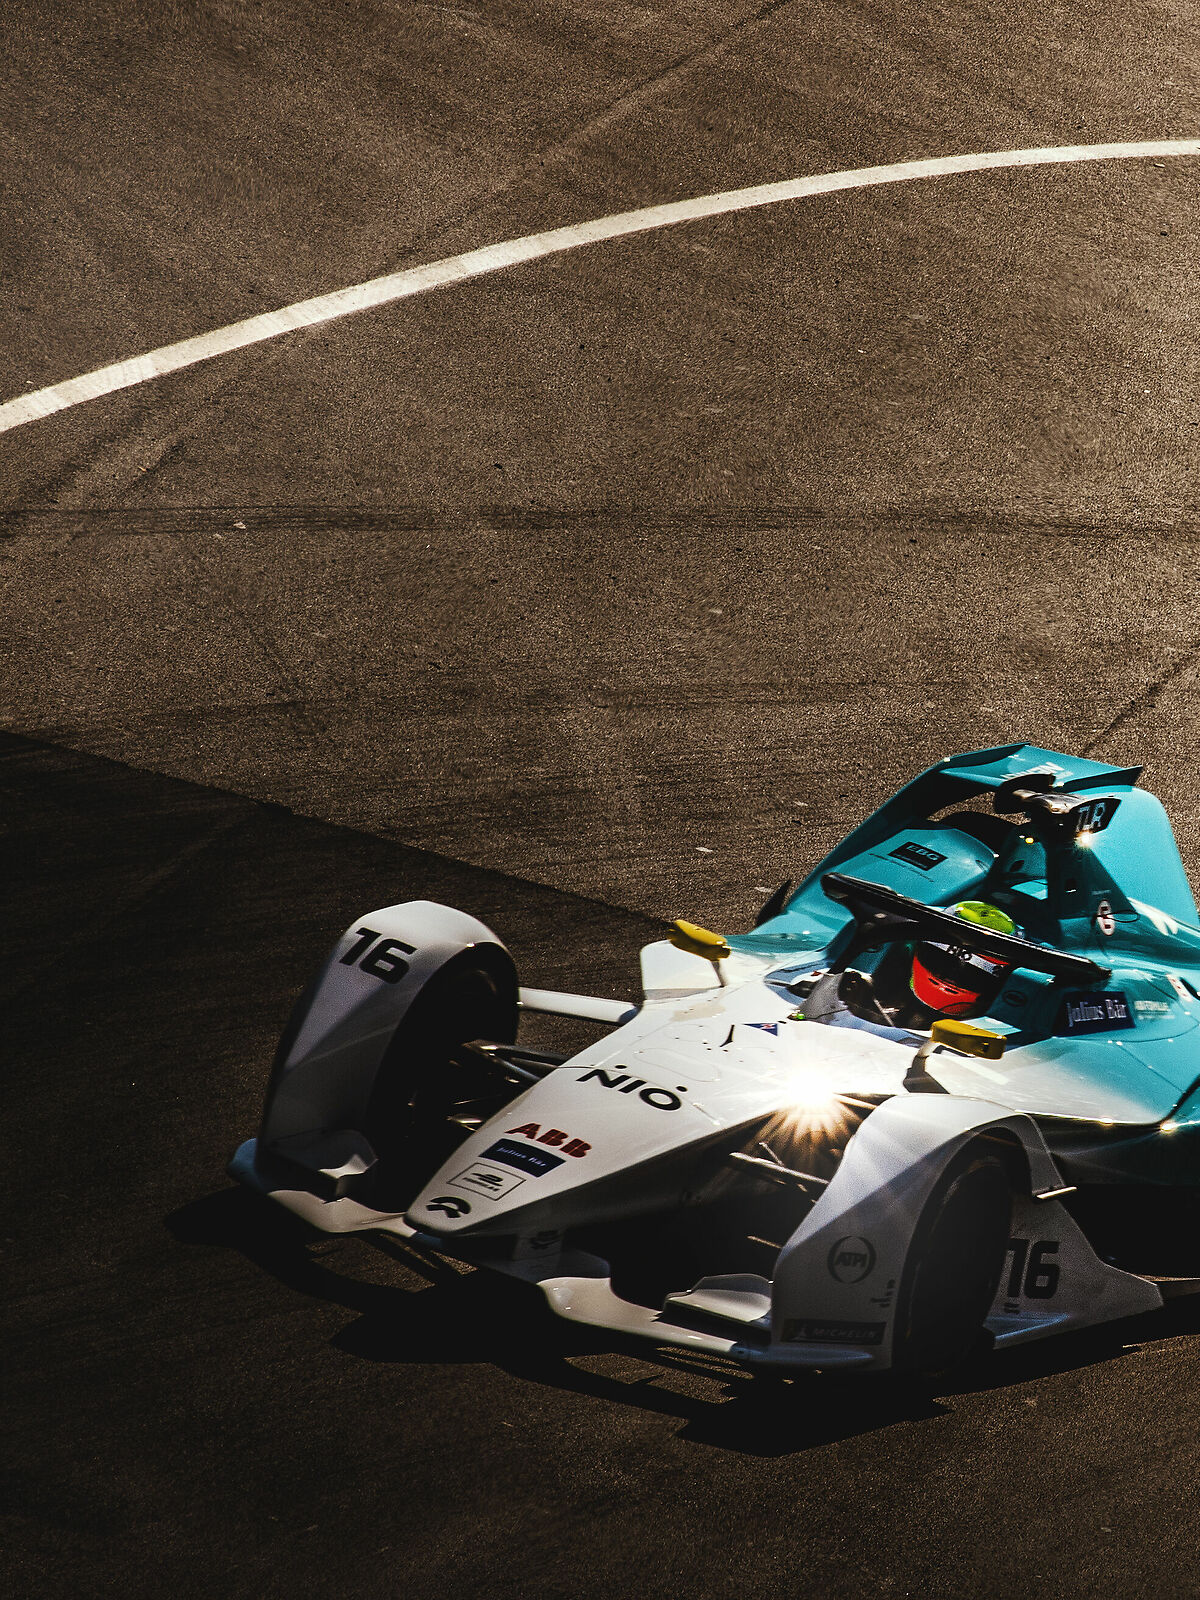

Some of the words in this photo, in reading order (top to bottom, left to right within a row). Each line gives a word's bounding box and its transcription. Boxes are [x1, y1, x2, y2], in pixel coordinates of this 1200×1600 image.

[906, 845, 940, 861] EBG
[339, 927, 417, 984] 16
[1066, 1001, 1104, 1027] Julius
[575, 1069, 682, 1111] NIO
[504, 1123, 592, 1158] ABB
[834, 1252, 867, 1268] ATPI
[1007, 1238, 1060, 1299] 16
